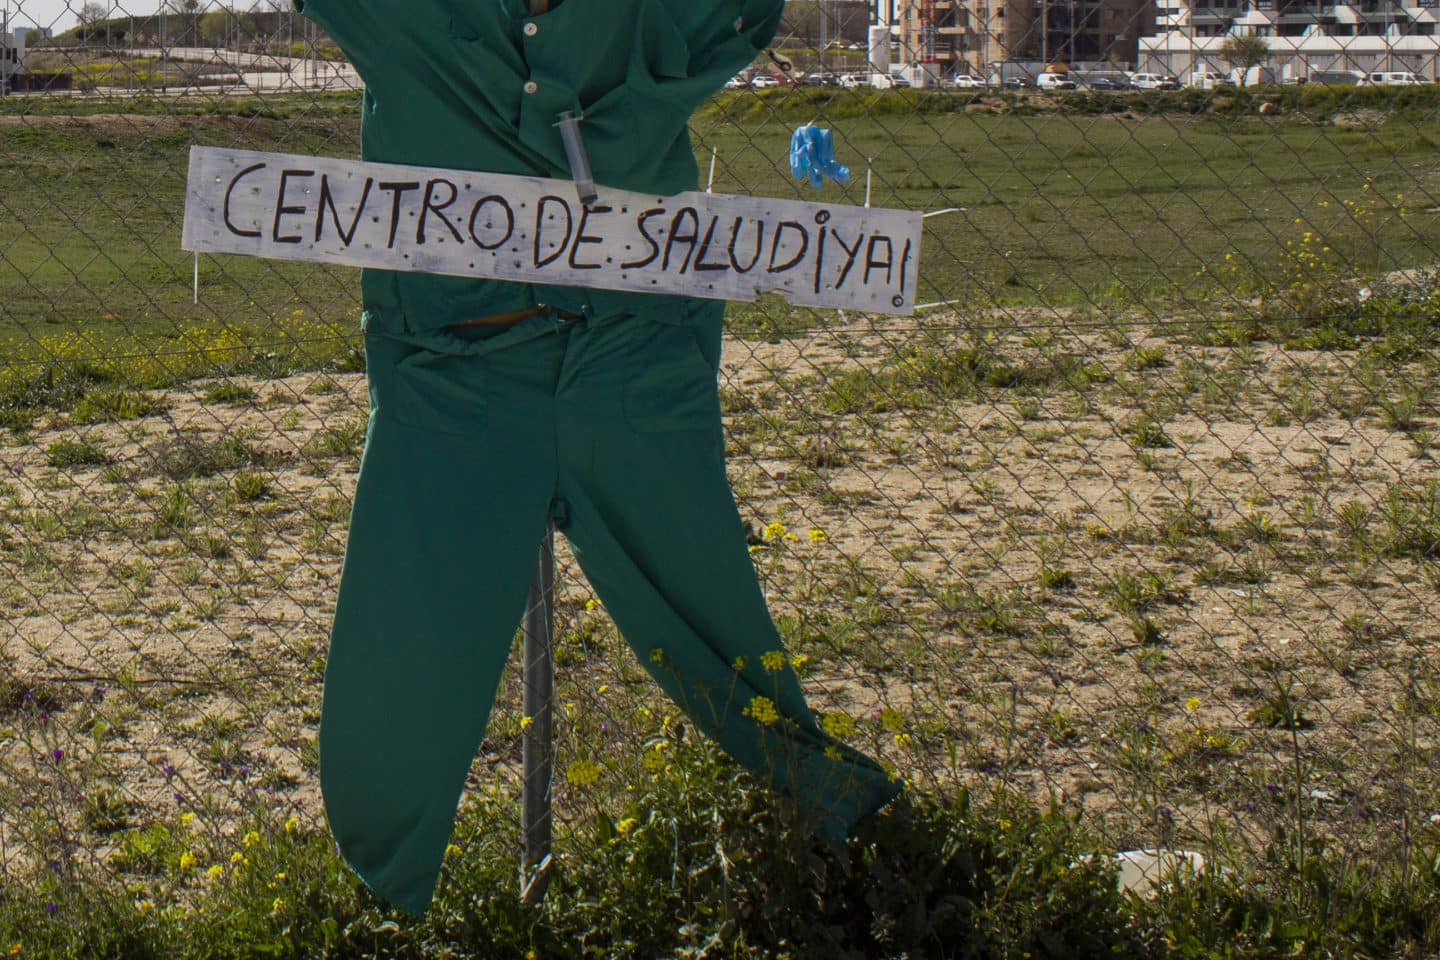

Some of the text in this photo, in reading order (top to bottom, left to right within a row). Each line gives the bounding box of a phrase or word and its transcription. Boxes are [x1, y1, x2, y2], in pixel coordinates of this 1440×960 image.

[223, 162, 515, 250] CENTRO
[534, 195, 613, 269] DE
[620, 206, 809, 274] SALUD
